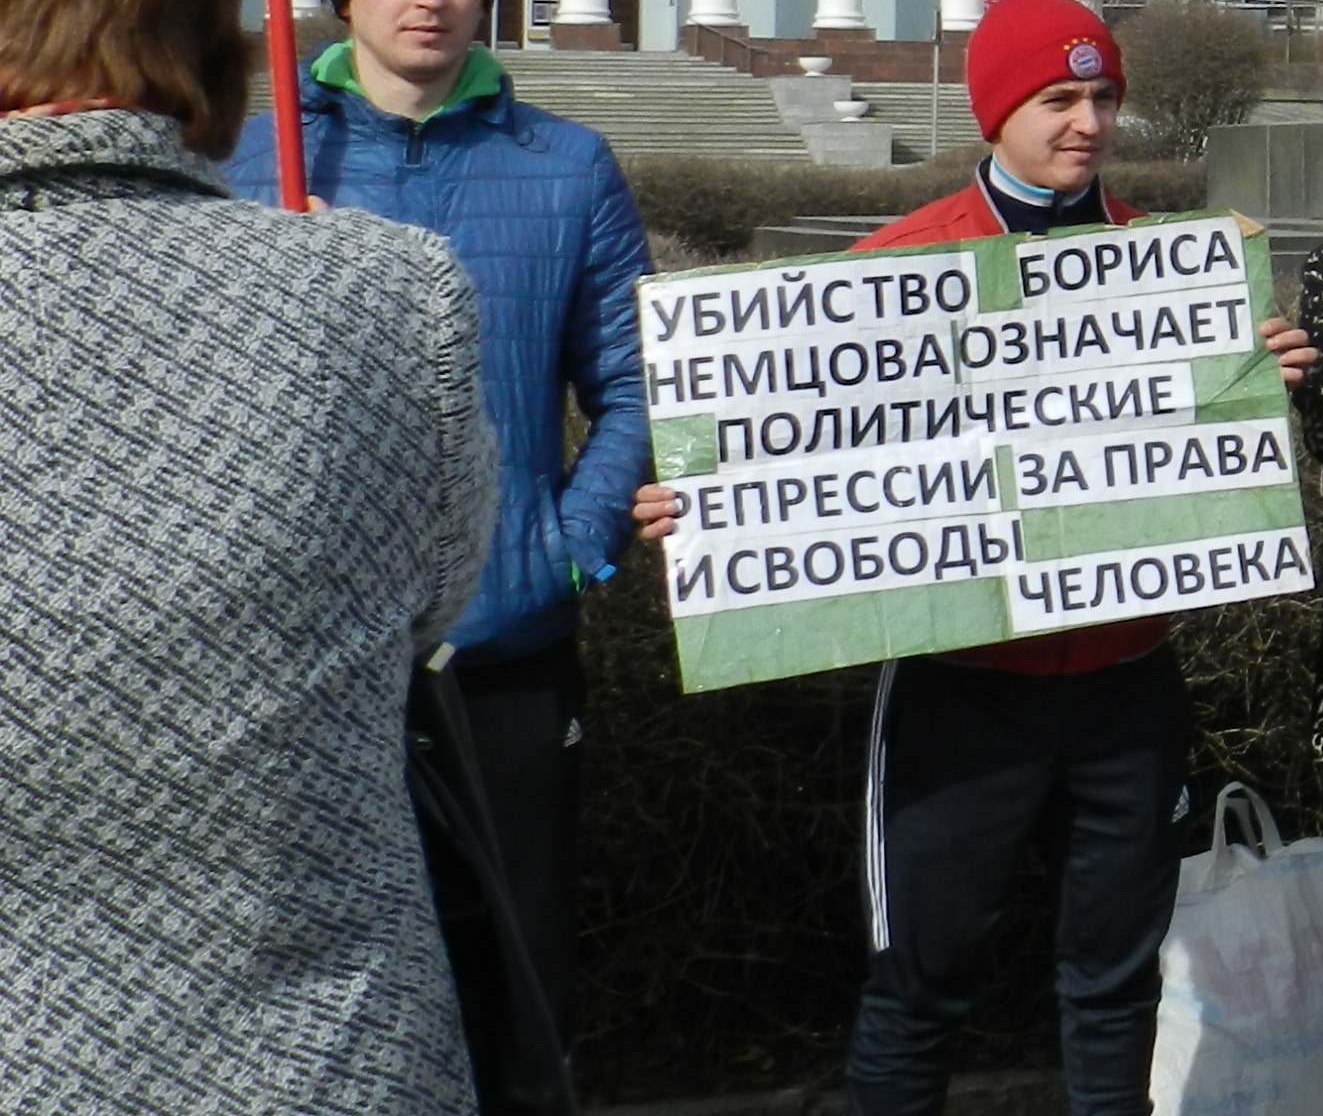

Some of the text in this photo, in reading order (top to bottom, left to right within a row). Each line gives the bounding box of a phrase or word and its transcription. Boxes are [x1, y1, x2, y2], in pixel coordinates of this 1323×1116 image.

[651, 229, 1240, 343] УБИЙСТВО БОРИСА
[649, 297, 1246, 406] НЕМЦОВА ОЗНАЧАЕТ
[717, 374, 1175, 464] ПОЛИТИЧЕСКИЕ
[1020, 450, 1088, 496] ЗА
[1104, 430, 1288, 486] ПРАВА
[676, 518, 1024, 601] И СВОБОДЫ
[1019, 536, 1309, 614] ЧЕЛОВЕКА
